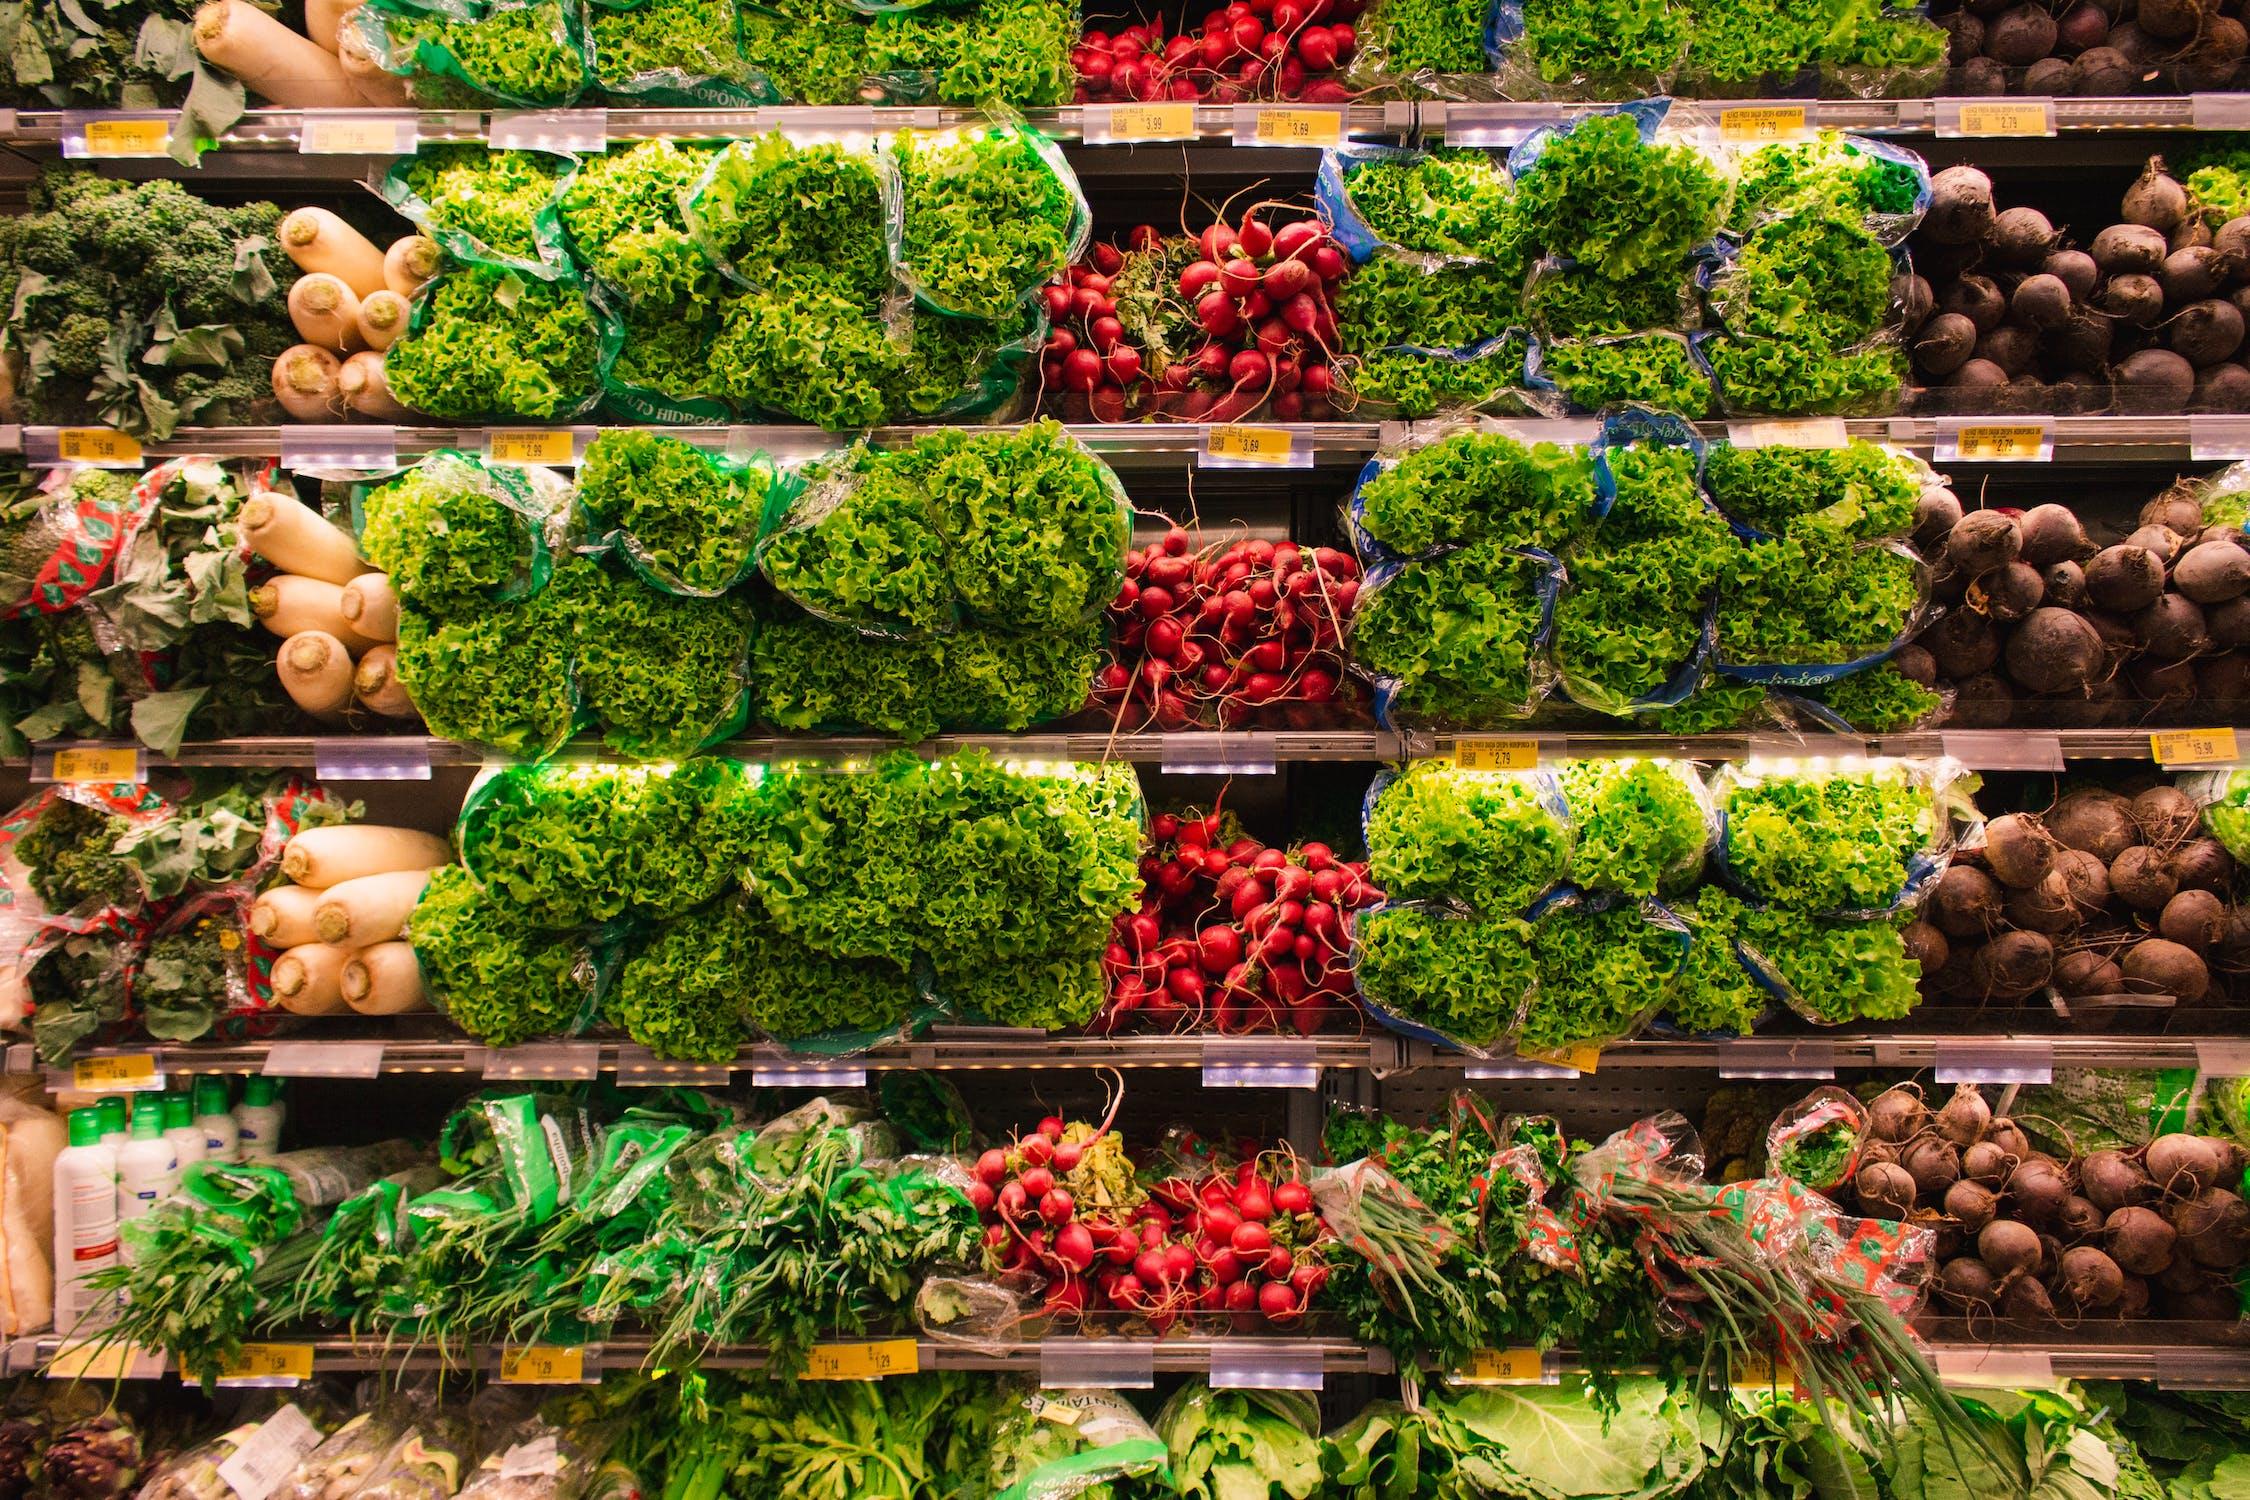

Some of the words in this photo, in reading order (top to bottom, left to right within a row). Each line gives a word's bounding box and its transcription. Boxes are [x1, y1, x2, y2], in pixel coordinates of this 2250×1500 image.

[1146, 117, 1162, 131] 3,99
[1293, 122, 1309, 136] 3,69
[1243, 439, 1259, 452] 3,69
[1495, 752, 1511, 765] 2,79
[552, 1131, 570, 1177] bolinha
[875, 1355, 890, 1368] 1,29
[1496, 1363, 1511, 1376] 1,29
